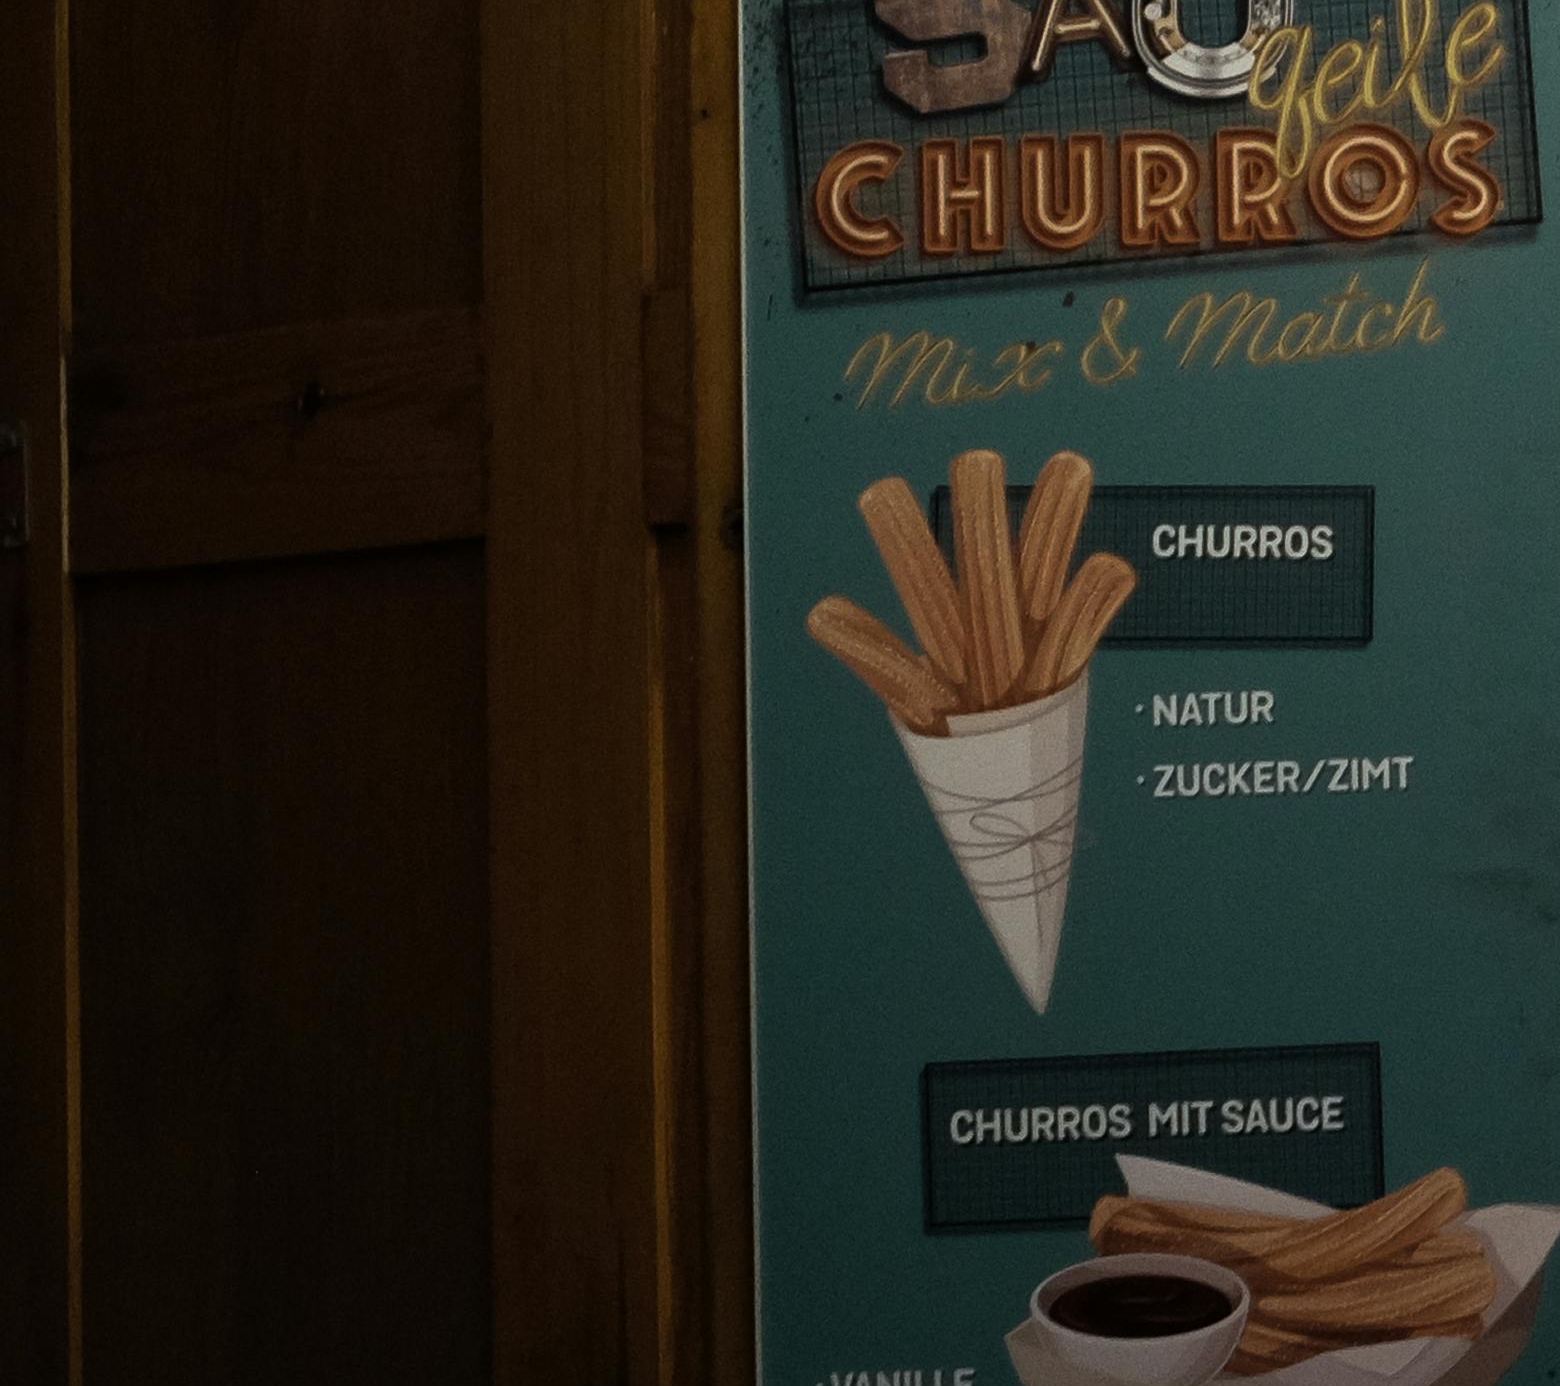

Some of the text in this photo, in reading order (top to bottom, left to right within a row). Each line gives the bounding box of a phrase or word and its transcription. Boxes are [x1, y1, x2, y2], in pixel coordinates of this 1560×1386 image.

[815, 120, 1504, 259] CHURROS
[844, 259, 1445, 413] Mix & Match
[1151, 523, 1336, 561] CHURROS
[1151, 690, 1276, 726] NATUR
[1151, 756, 1415, 798] ZUCKER/ZIMT
[949, 1095, 1346, 1144] CHURROS MIT SAUCE
